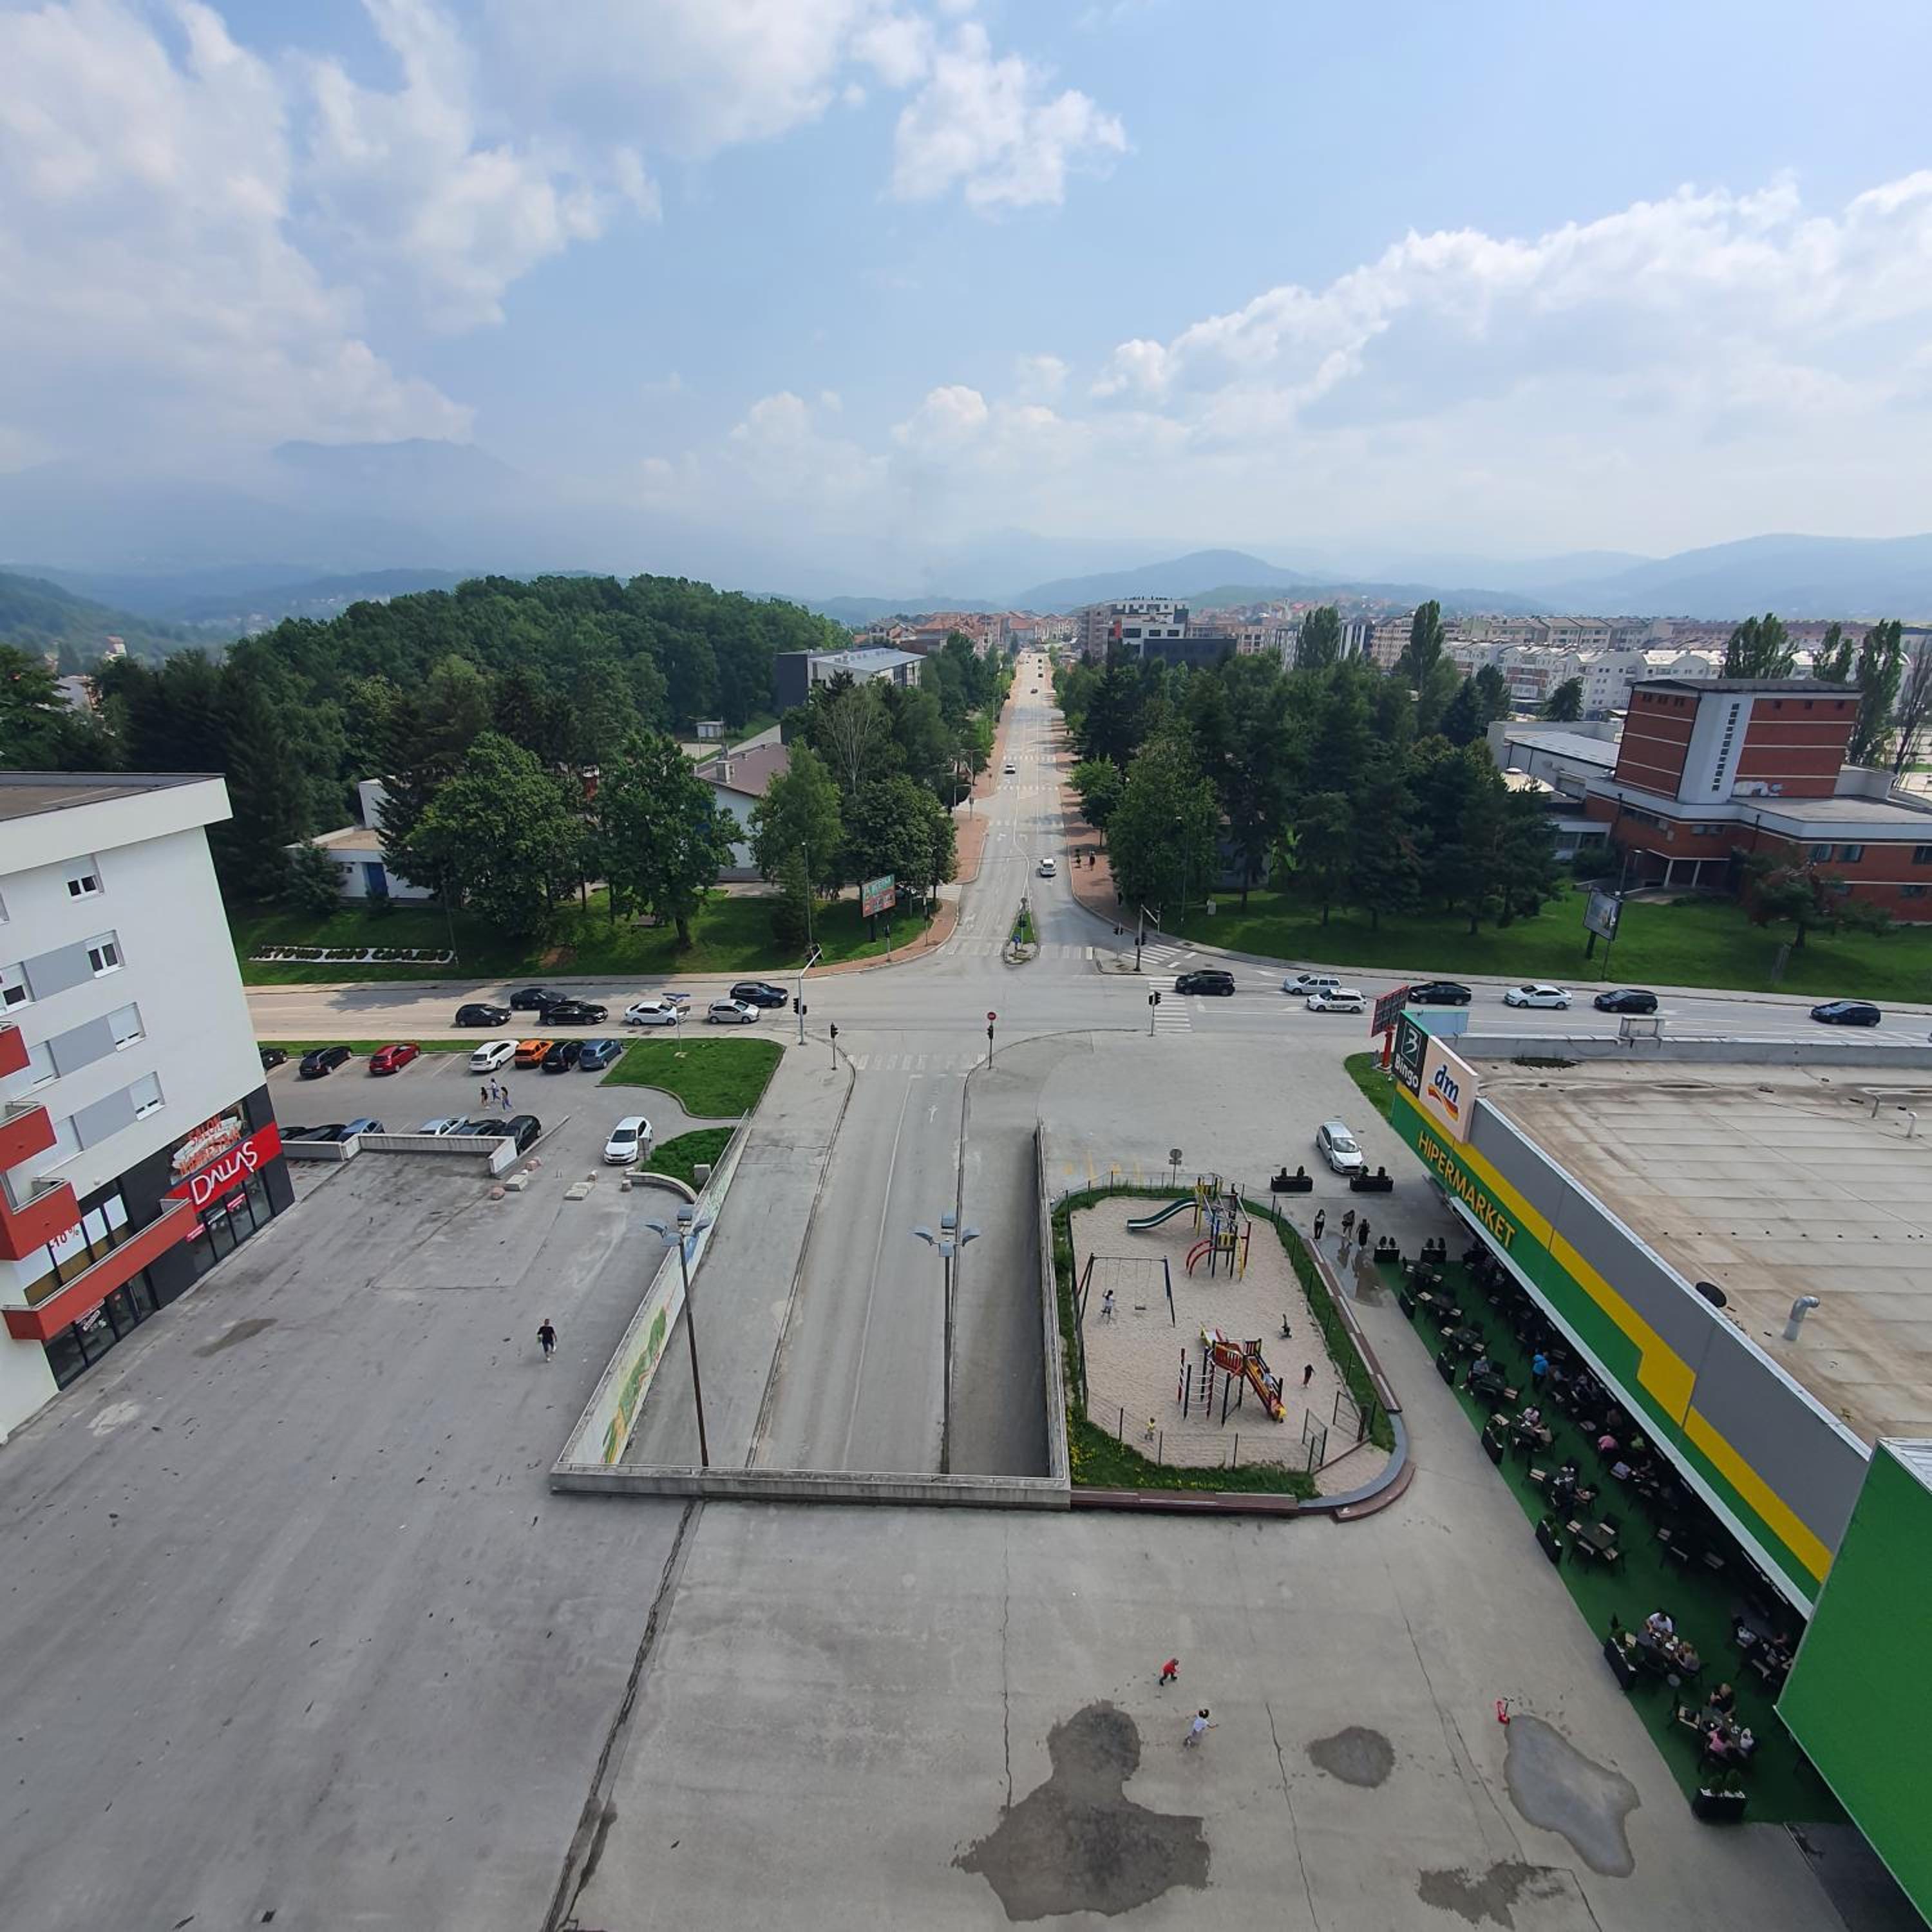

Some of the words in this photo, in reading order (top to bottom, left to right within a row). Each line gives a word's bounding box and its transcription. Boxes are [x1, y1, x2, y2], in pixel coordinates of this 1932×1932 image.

[1394, 1054, 1419, 1088] Bingo
[1434, 1064, 1459, 1103] dm
[191, 1140, 258, 1205] DALLAS
[1418, 1130, 1515, 1247] HIPERMARKET
